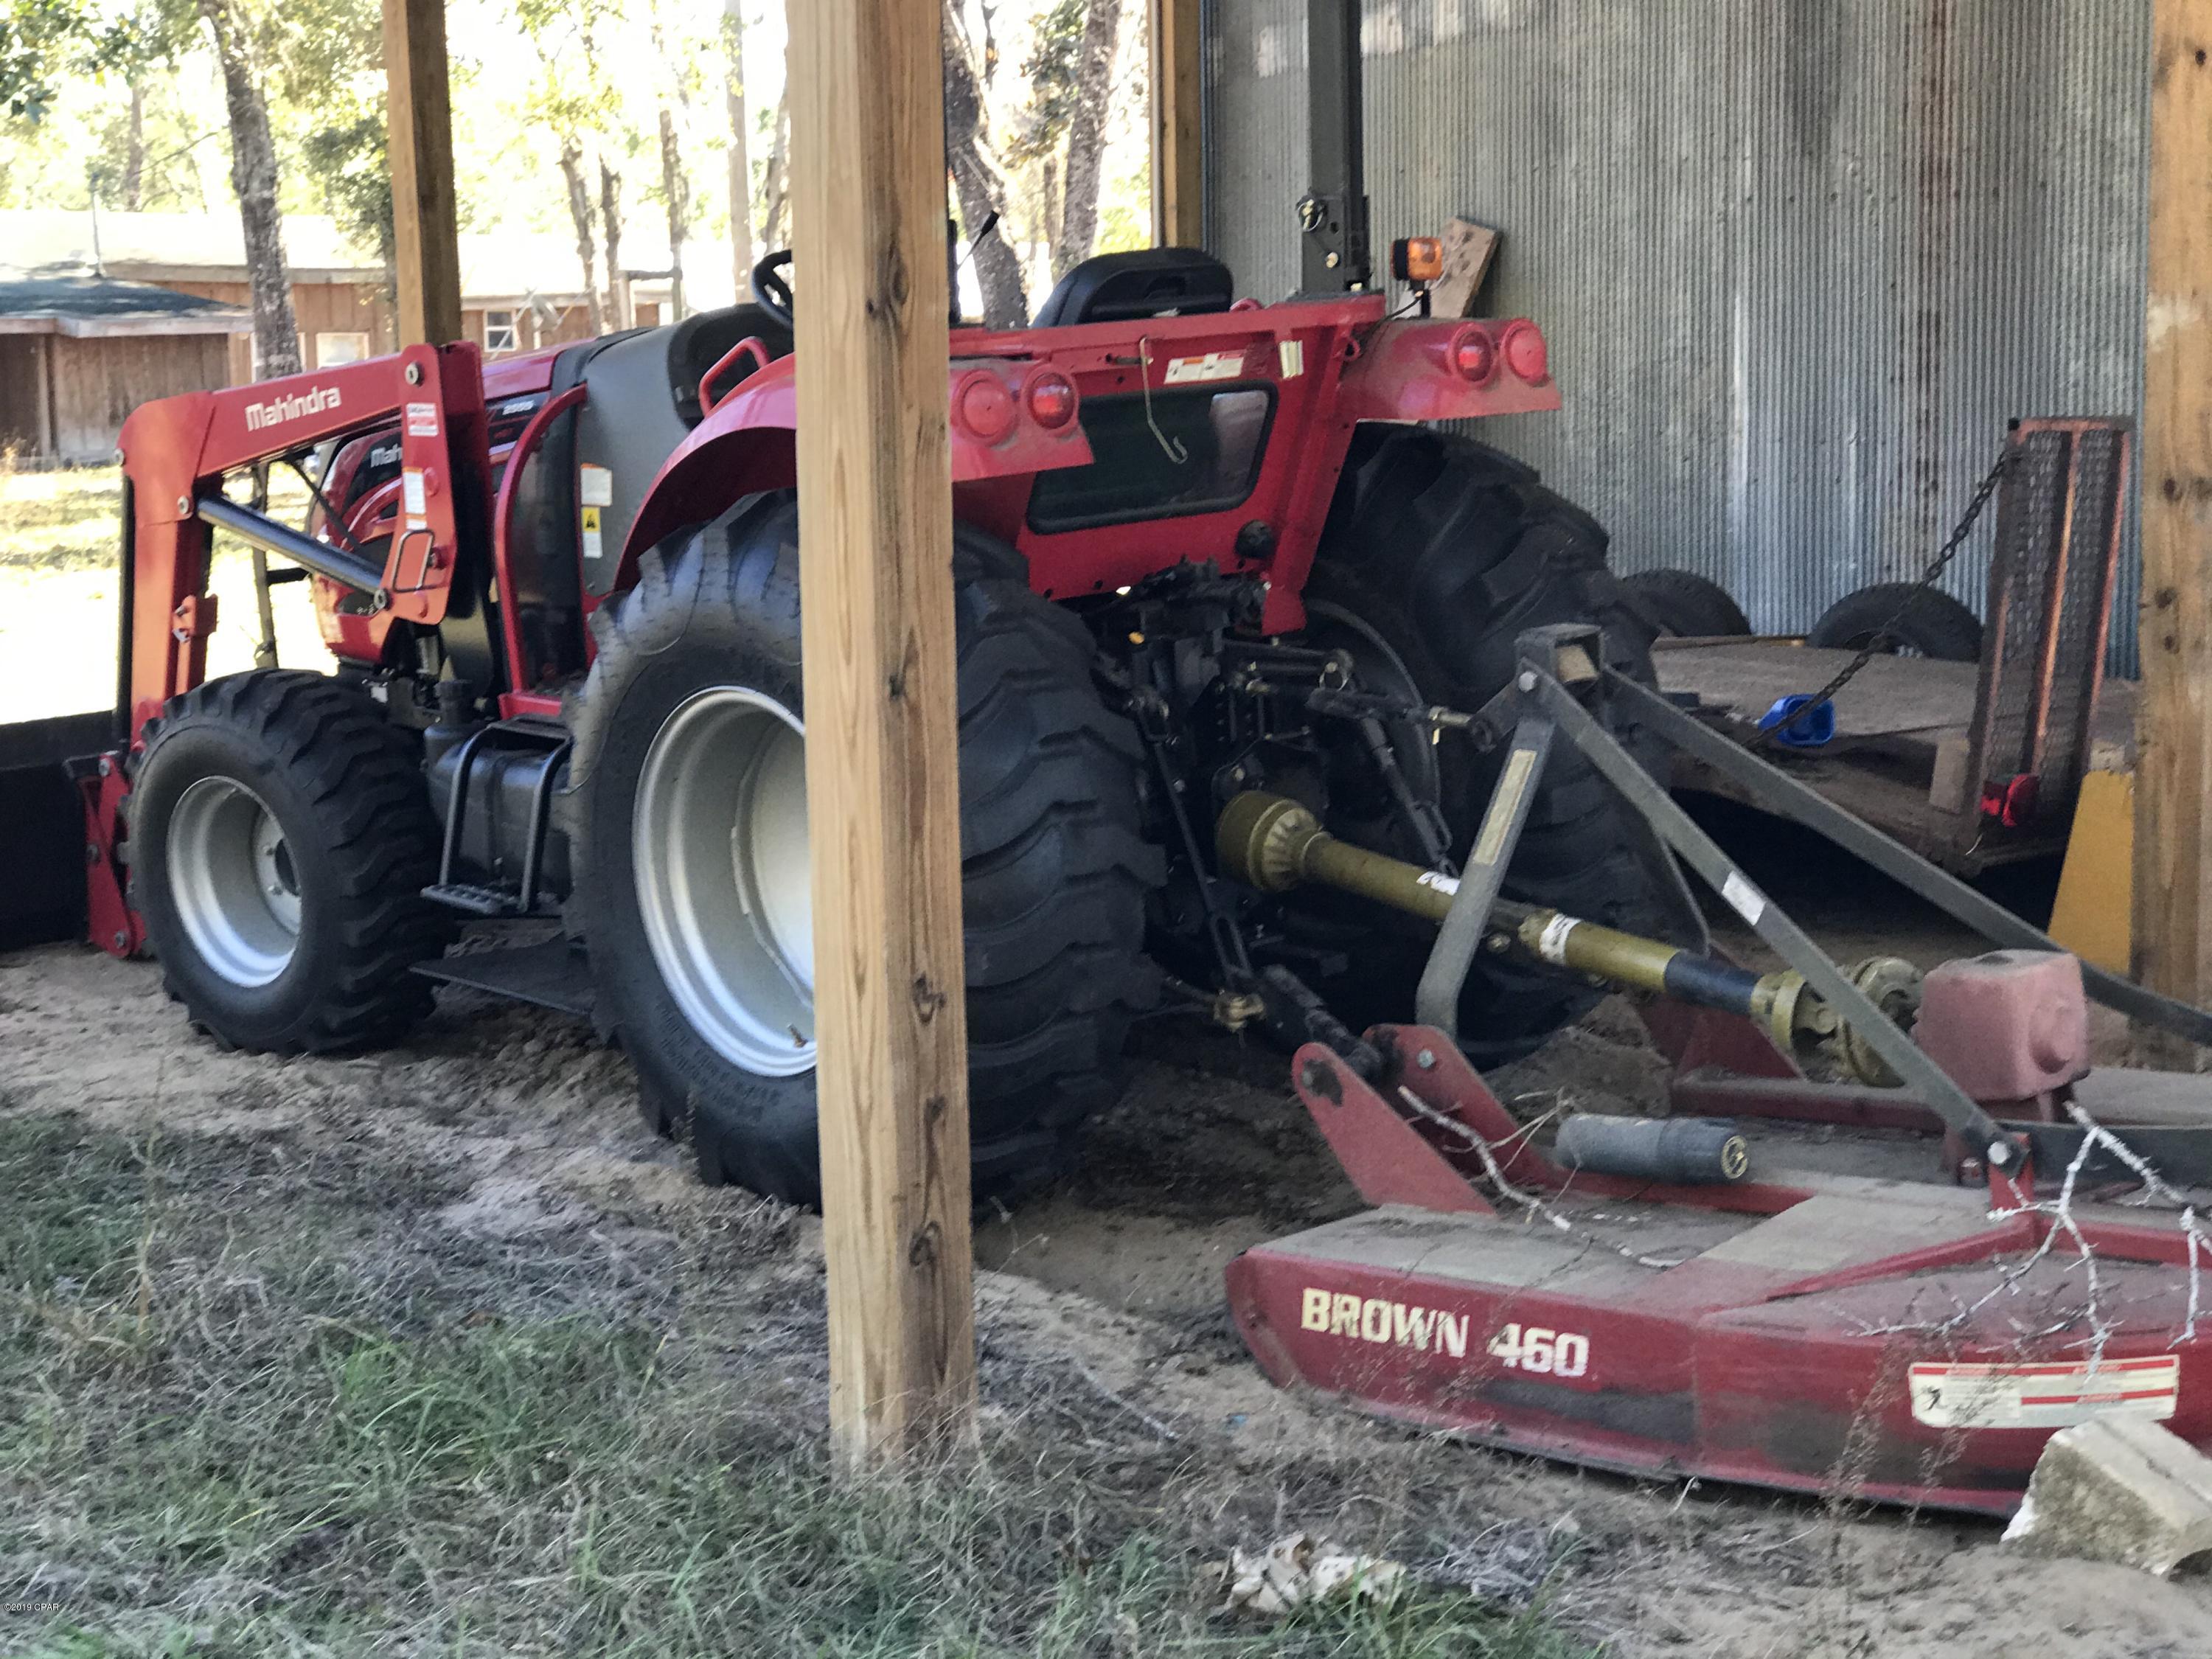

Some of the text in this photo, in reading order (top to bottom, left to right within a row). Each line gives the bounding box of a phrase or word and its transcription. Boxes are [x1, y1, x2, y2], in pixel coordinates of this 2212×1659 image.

[245, 385, 341, 432] Mahindra
[371, 444, 403, 467] Mah
[1301, 1287, 1590, 1378] BROWN 460
